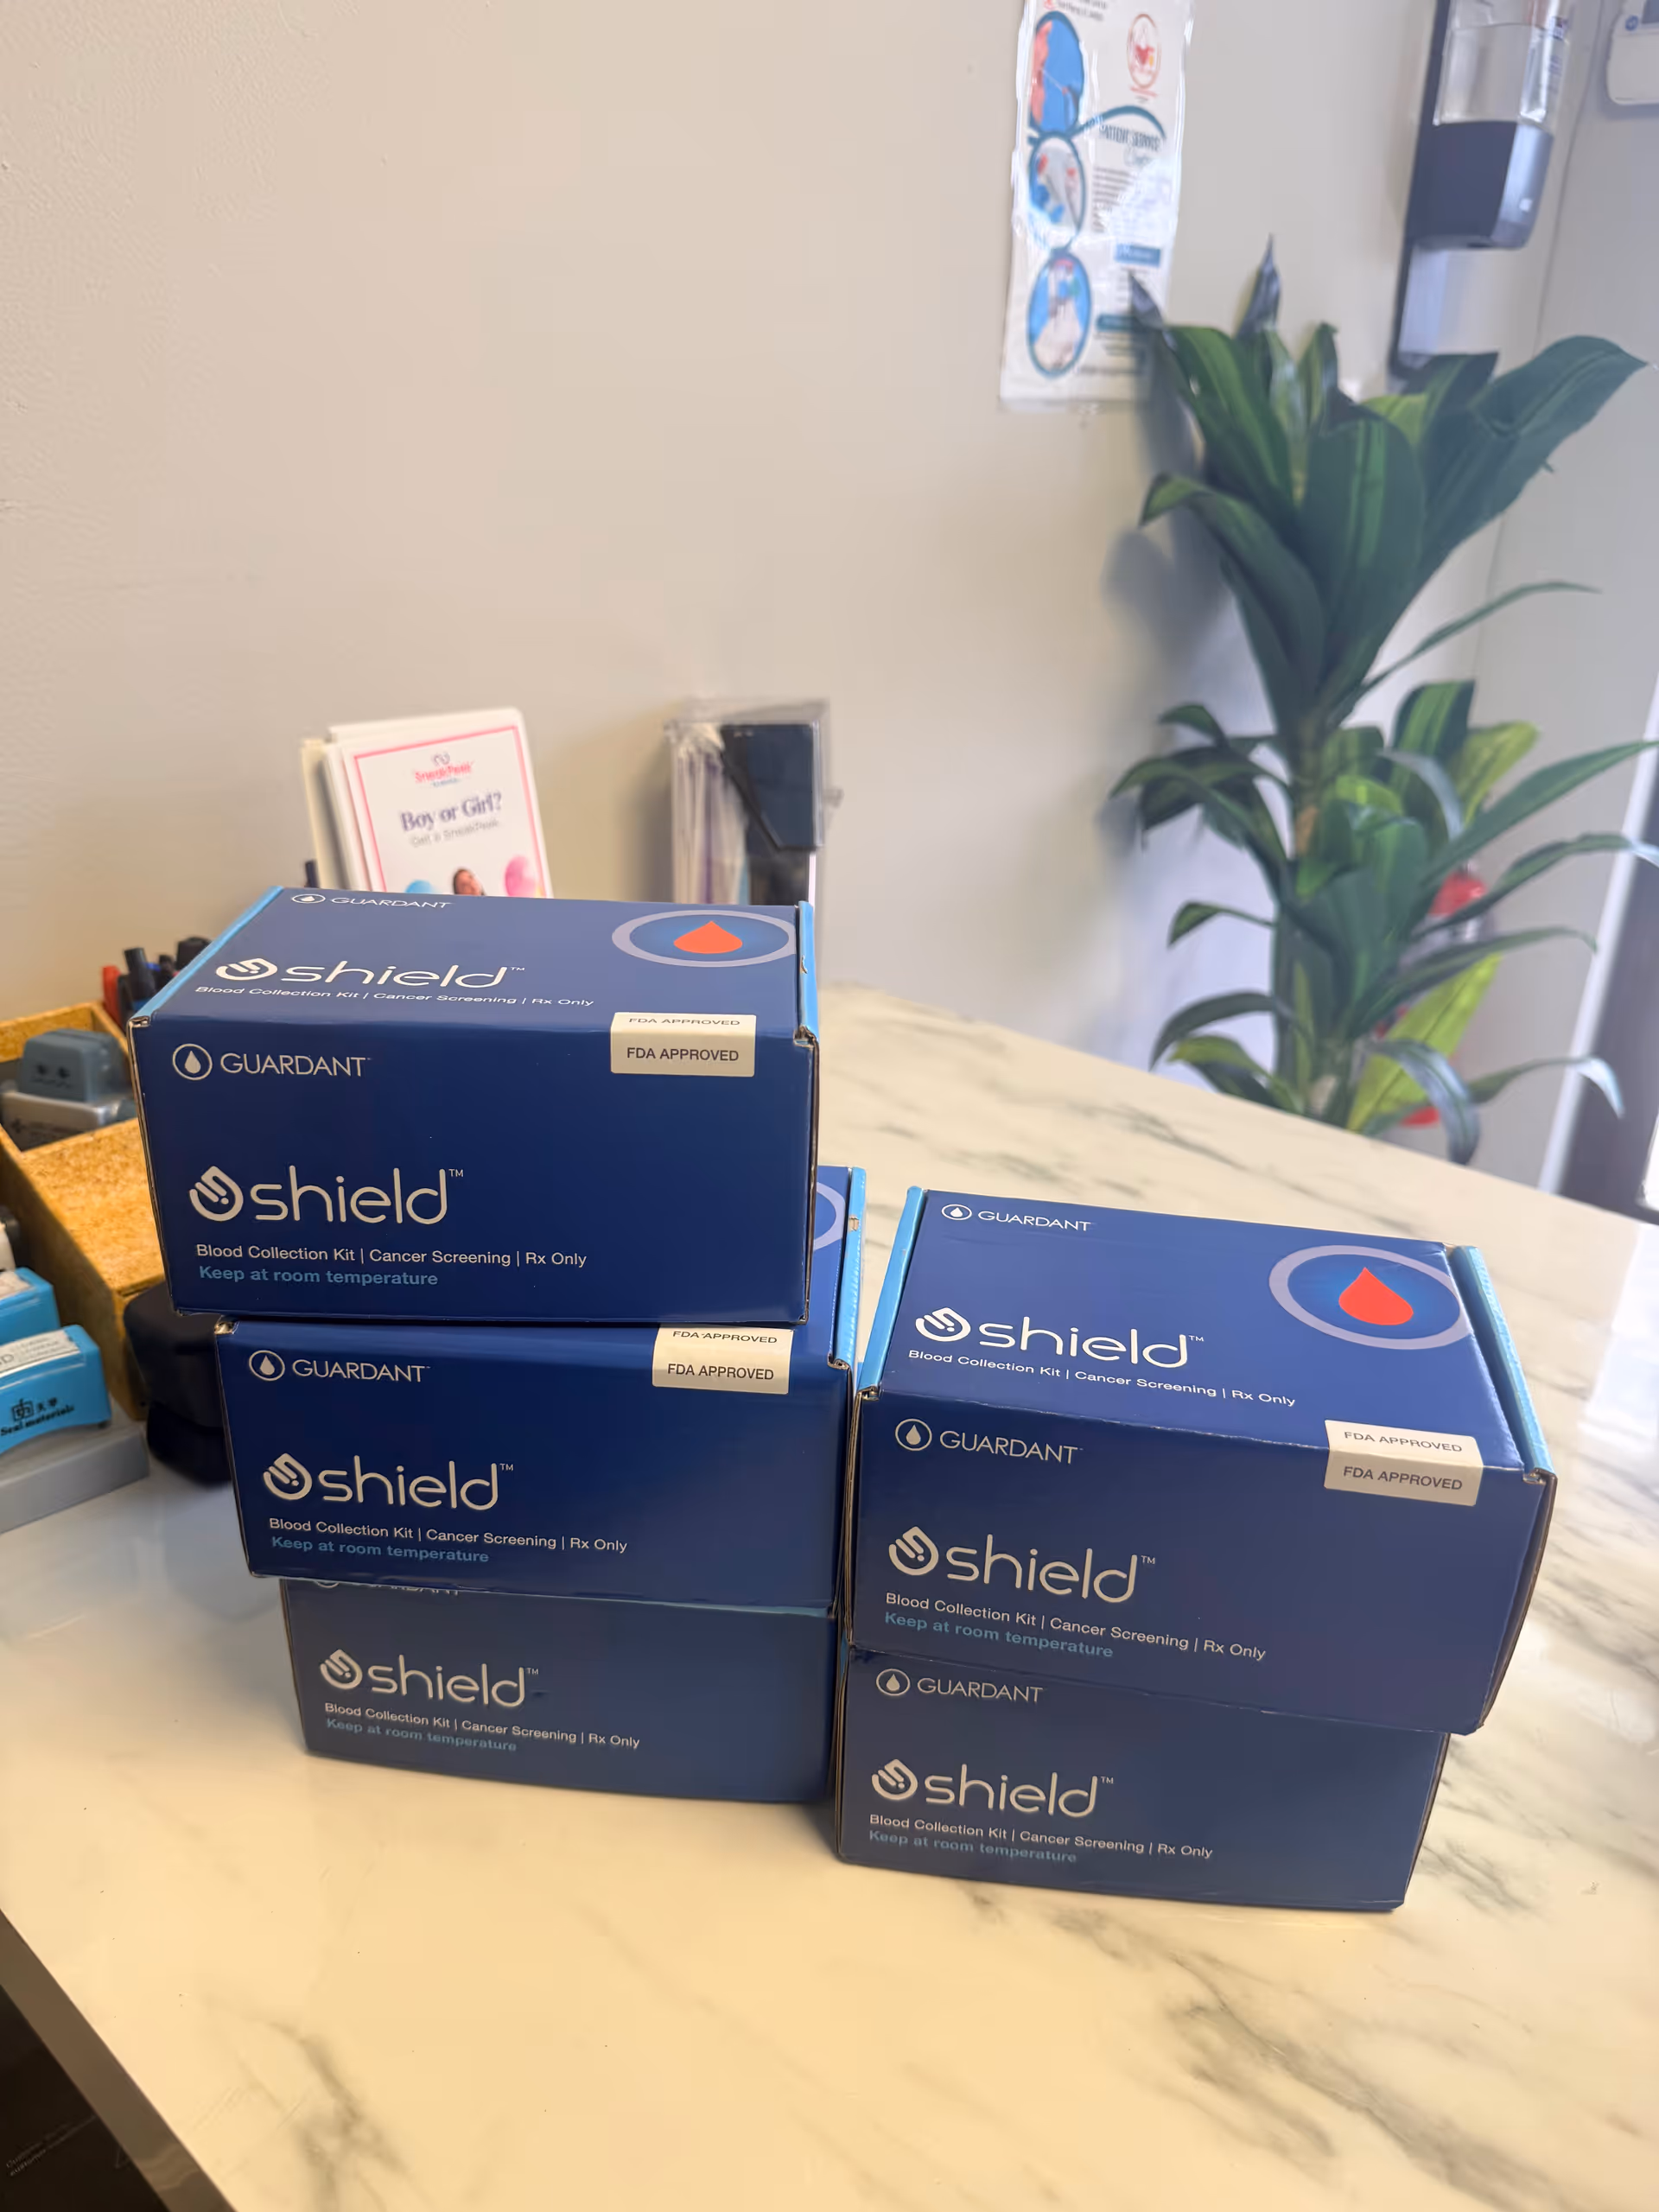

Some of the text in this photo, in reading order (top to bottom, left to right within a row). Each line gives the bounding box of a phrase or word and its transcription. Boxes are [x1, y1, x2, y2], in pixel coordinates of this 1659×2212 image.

[401, 792, 502, 831] Boy or Girl?
[330, 897, 451, 909] GUARDANT
[248, 988, 332, 997] Collection
[436, 995, 517, 1004] Screening
[219, 1052, 366, 1077] GUARDANT
[626, 1046, 740, 1062] FDA APPROVED
[977, 1211, 1091, 1231] GUARDANT
[196, 1243, 243, 1258] Blood
[248, 1245, 328, 1261] Collection
[334, 1248, 356, 1262] Kit
[369, 1249, 428, 1262] Cancer
[432, 1249, 511, 1268] Screening
[525, 1252, 546, 1265] Rx
[551, 1252, 588, 1268] Only
[199, 1265, 438, 1287] Keep at room temperature
[702, 1332, 778, 1344] APPROVED
[292, 1359, 426, 1382] GUARDANT
[667, 1363, 774, 1381] FDA APPROVED
[908, 1350, 953, 1363] Blood
[957, 1356, 1034, 1374] Collection
[1039, 1366, 1061, 1377] Kit
[1074, 1370, 1132, 1385] Cancer
[1136, 1378, 1217, 1397] Screening
[1231, 1389, 1254, 1401] Rx
[1258, 1393, 1295, 1408] Only
[939, 1430, 1078, 1465] GUARDANT
[1344, 1431, 1463, 1452] FDA APPROVED
[1343, 1465, 1463, 1491] FDA APPROVED
[269, 1517, 312, 1532] Blood
[315, 1521, 389, 1537] Collection
[393, 1527, 414, 1539] Kit
[426, 1529, 480, 1542] Cancer
[483, 1532, 556, 1550] Screening
[570, 1537, 589, 1549] Rx
[594, 1538, 627, 1554] Only
[271, 1536, 490, 1563] Keep at room temperature
[885, 1611, 1114, 1657] Keep at room temperature
[886, 1592, 930, 1610] Blood
[934, 1599, 1010, 1622] Collection
[1015, 1611, 1037, 1626] Kit
[1050, 1617, 1106, 1637] Cancer
[1110, 1626, 1189, 1651] Screening
[1203, 1639, 1224, 1654] Rx
[1230, 1643, 1266, 1662] Only
[917, 1677, 1044, 1702] GUARDANT
[324, 1702, 362, 1717] Blood
[365, 1707, 429, 1726] Collection
[433, 1716, 450, 1728] Kit
[461, 1719, 509, 1734] Cancer
[512, 1726, 577, 1743] Screening
[588, 1732, 606, 1744] Rx
[610, 1735, 640, 1749] Only
[327, 1718, 517, 1751] Keep at room temperature
[869, 1814, 910, 1828] Blood
[914, 1819, 983, 1837] Collection
[988, 1827, 1007, 1840] Kit
[1020, 1830, 1071, 1846] Cancer
[1074, 1835, 1145, 1853] Screening
[1157, 1843, 1176, 1855] Rx
[1180, 1845, 1213, 1859] Only
[869, 1829, 1077, 1863] Keep at room temperature
